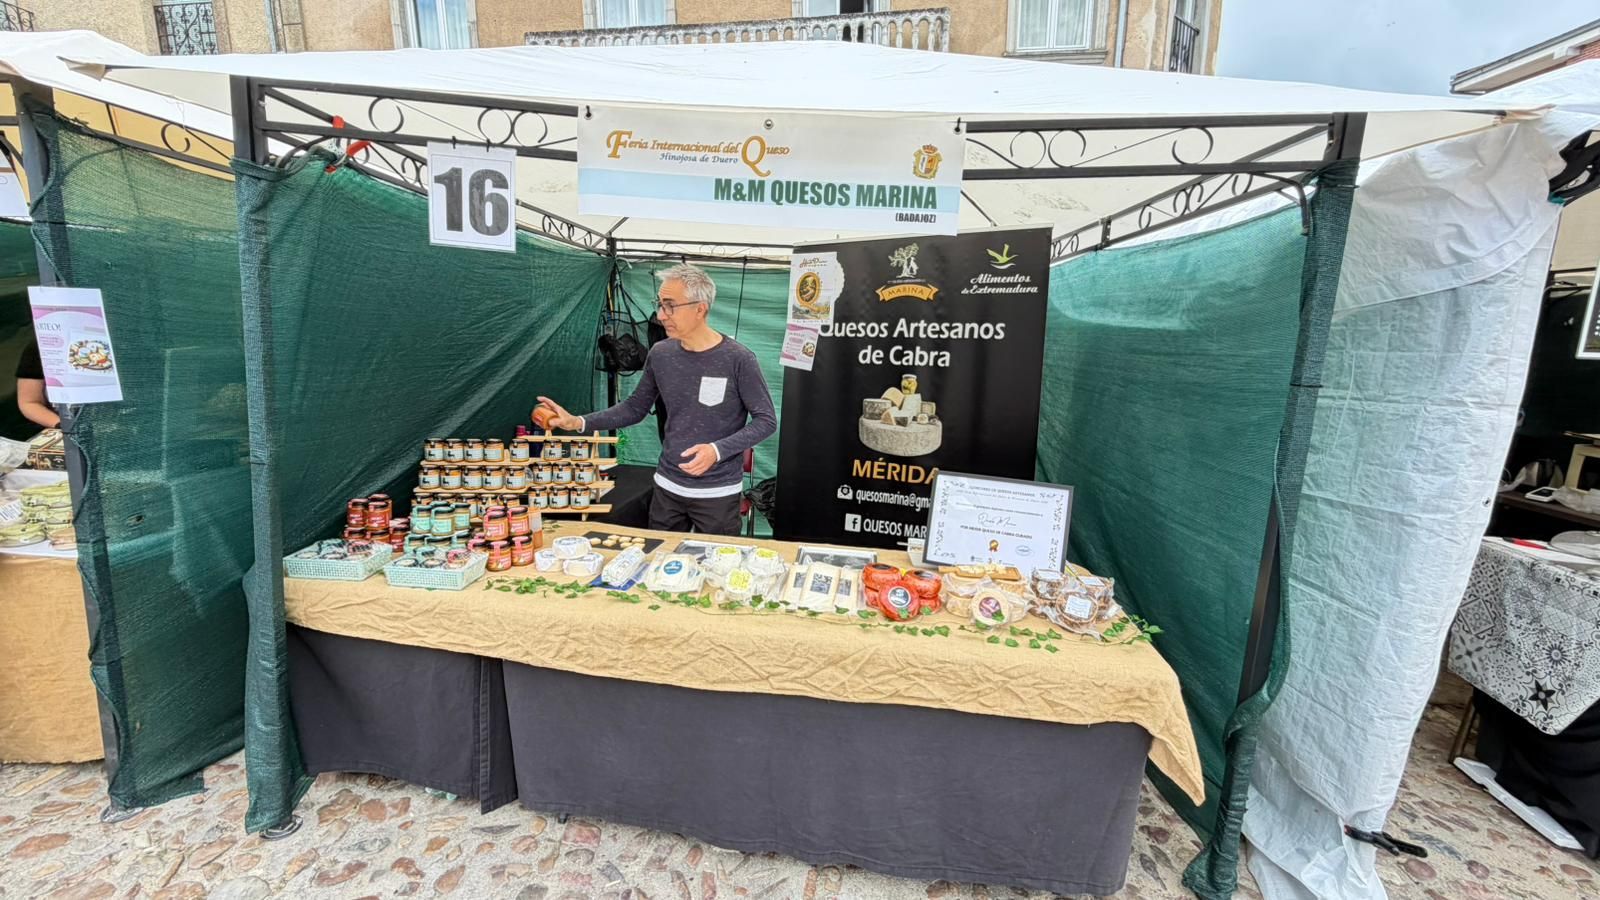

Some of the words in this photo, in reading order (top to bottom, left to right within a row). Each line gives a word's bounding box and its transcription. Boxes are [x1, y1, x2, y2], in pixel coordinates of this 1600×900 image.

[606, 130, 648, 158] Feria
[650, 139, 721, 154] Internacional
[722, 142, 742, 154] del
[741, 135, 790, 177] Queso
[660, 152, 697, 164] Hinojosa
[699, 154, 709, 163] de
[711, 155, 739, 164] Duero
[434, 167, 509, 236] 16
[714, 178, 766, 203] M&M
[770, 180, 851, 206] QUESOS
[856, 184, 938, 209] MARINA
[895, 212, 937, 224] (BADAJOZ)
[970, 273, 1032, 285] Alimentos
[887, 286, 924, 297] MARINA
[969, 284, 1039, 295] Extremadura
[893, 317, 1006, 340] Artesanos
[858, 345, 884, 365] de
[889, 345, 951, 367] Cabra
[863, 518, 902, 537] QUESOS
